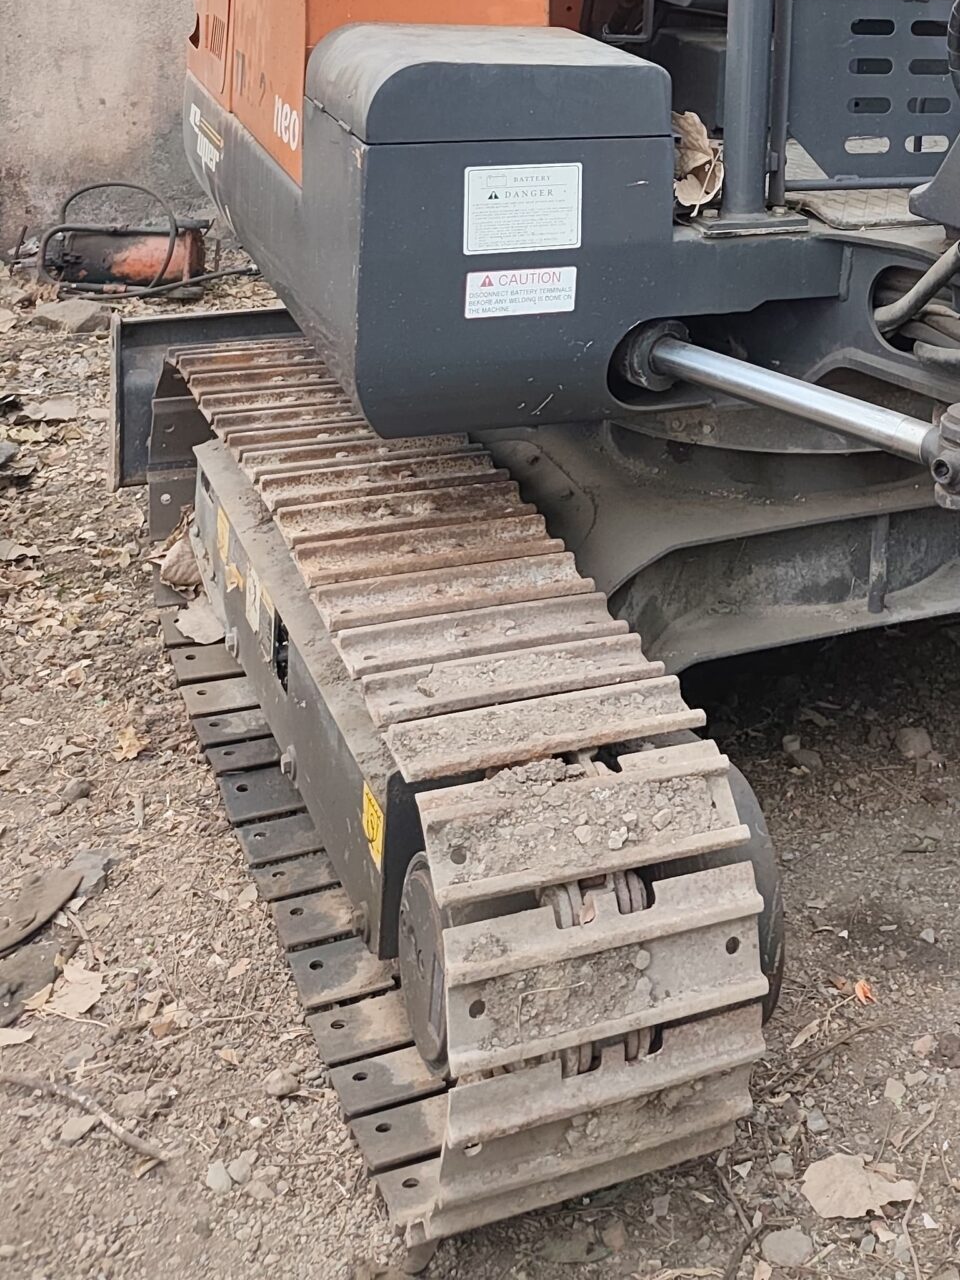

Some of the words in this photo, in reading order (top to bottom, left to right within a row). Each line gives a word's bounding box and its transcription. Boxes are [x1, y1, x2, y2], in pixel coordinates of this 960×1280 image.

[273, 94, 299, 151] neo
[513, 175, 551, 183] BATTERY
[504, 189, 554, 199] DANGER
[498, 271, 561, 286] CAUTION
[469, 290, 509, 299] DISCONNECT
[510, 288, 537, 297] BATTERY
[539, 286, 572, 295] TERMINALS
[468, 298, 493, 307] BEFORE
[493, 297, 507, 305] ANY
[508, 296, 537, 304] WELDING
[538, 295, 544, 303] IS
[545, 294, 561, 302] DONE
[562, 293, 572, 301] ON
[468, 306, 480, 315] THE
